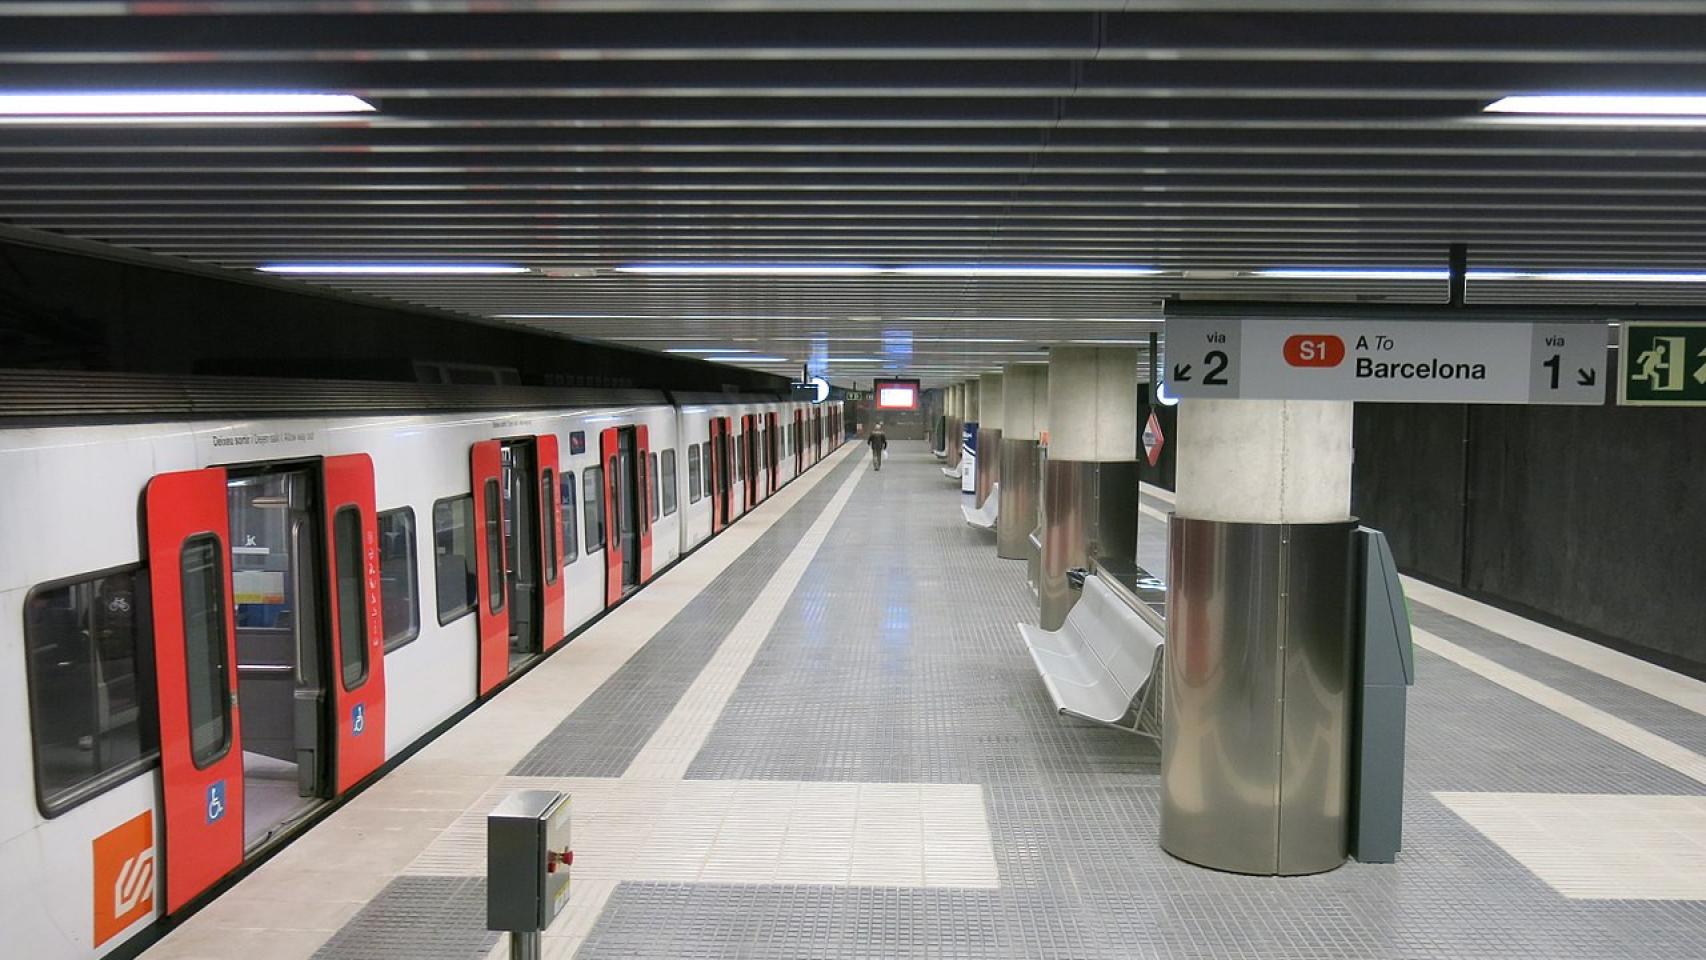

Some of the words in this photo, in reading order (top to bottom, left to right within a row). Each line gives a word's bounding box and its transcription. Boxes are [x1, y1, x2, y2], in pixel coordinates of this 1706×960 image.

[1206, 331, 1226, 344] via
[1355, 335, 1369, 351] A
[1375, 335, 1394, 351] To
[1545, 335, 1566, 347] via
[1299, 340, 1327, 361] S1
[1202, 350, 1229, 386] 2
[1355, 357, 1486, 380] Barcelona
[1543, 354, 1561, 390] 1
